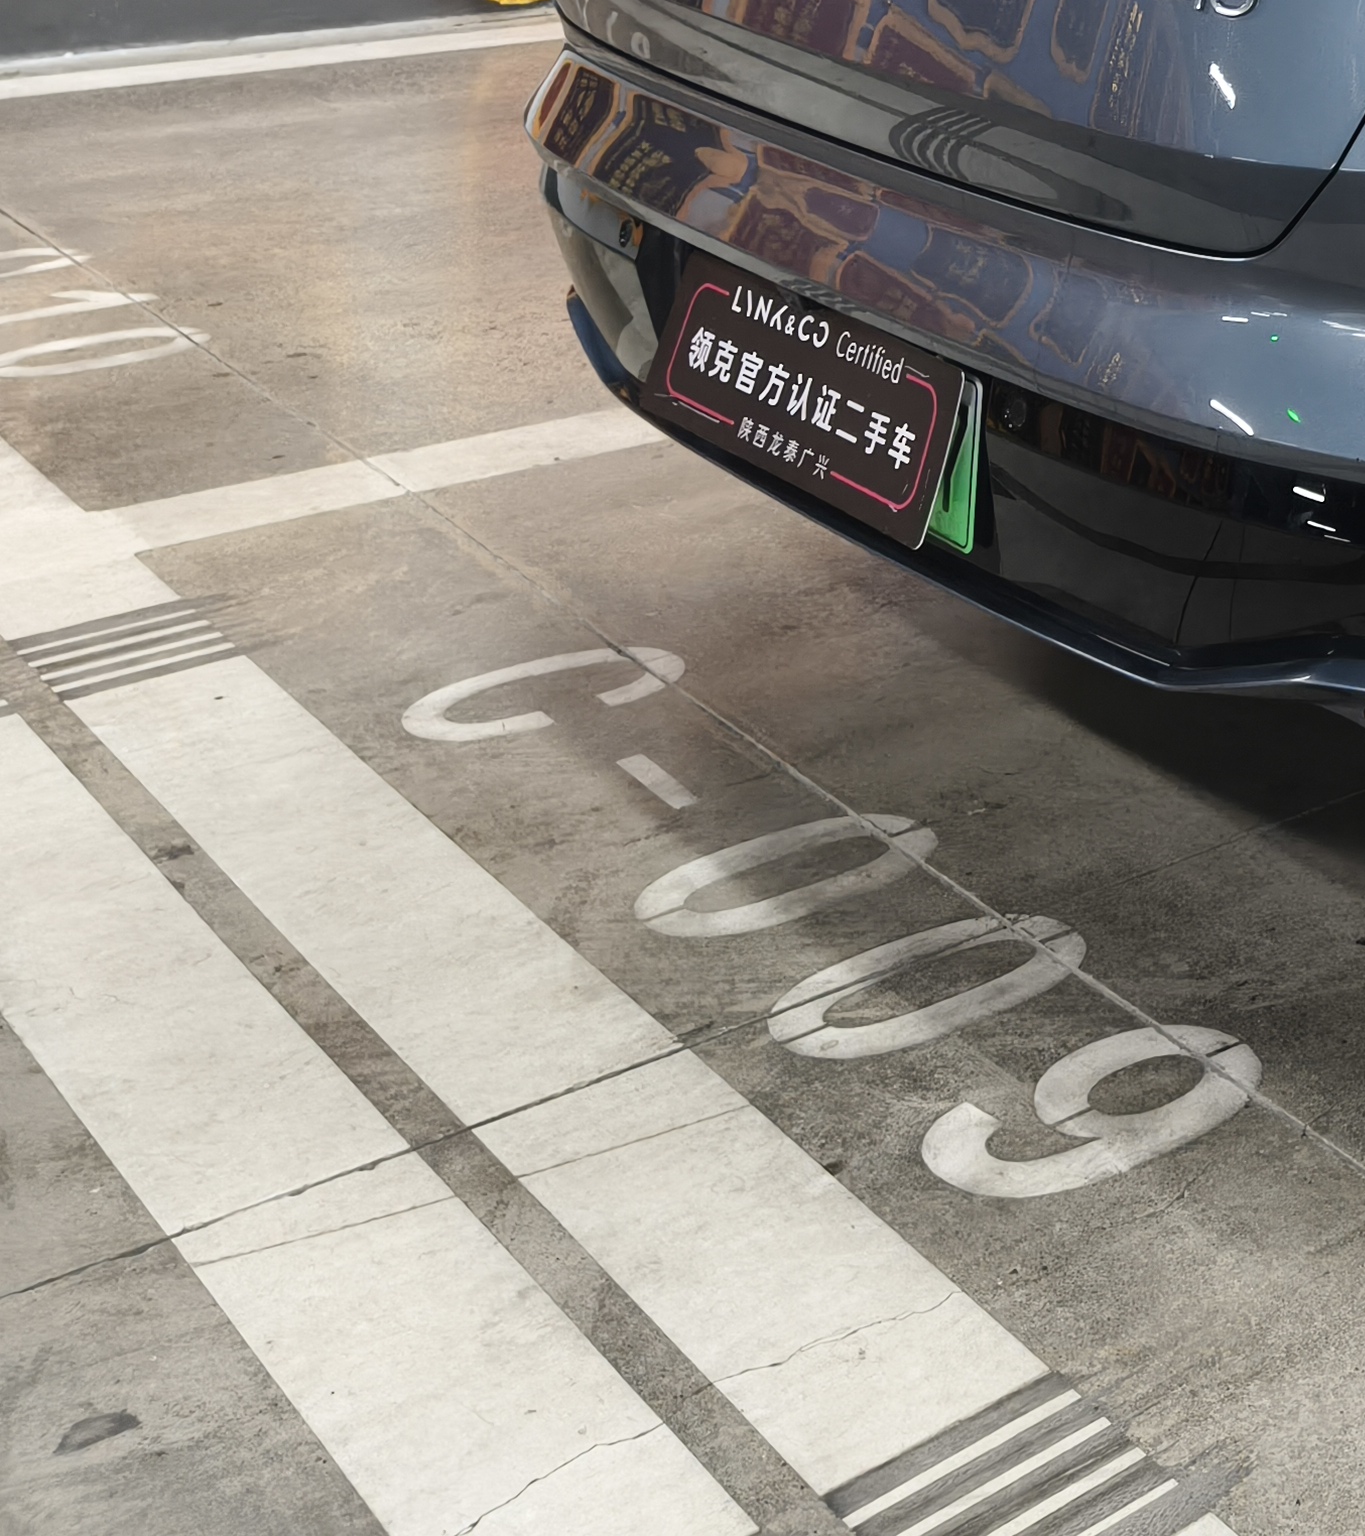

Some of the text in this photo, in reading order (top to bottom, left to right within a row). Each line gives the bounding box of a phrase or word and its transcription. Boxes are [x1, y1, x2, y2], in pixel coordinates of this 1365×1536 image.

[688, 325, 916, 470] 领克官方认证二手车
[731, 285, 905, 384] LYNK&CO Certified
[402, 646, 1263, 1199] C-009
